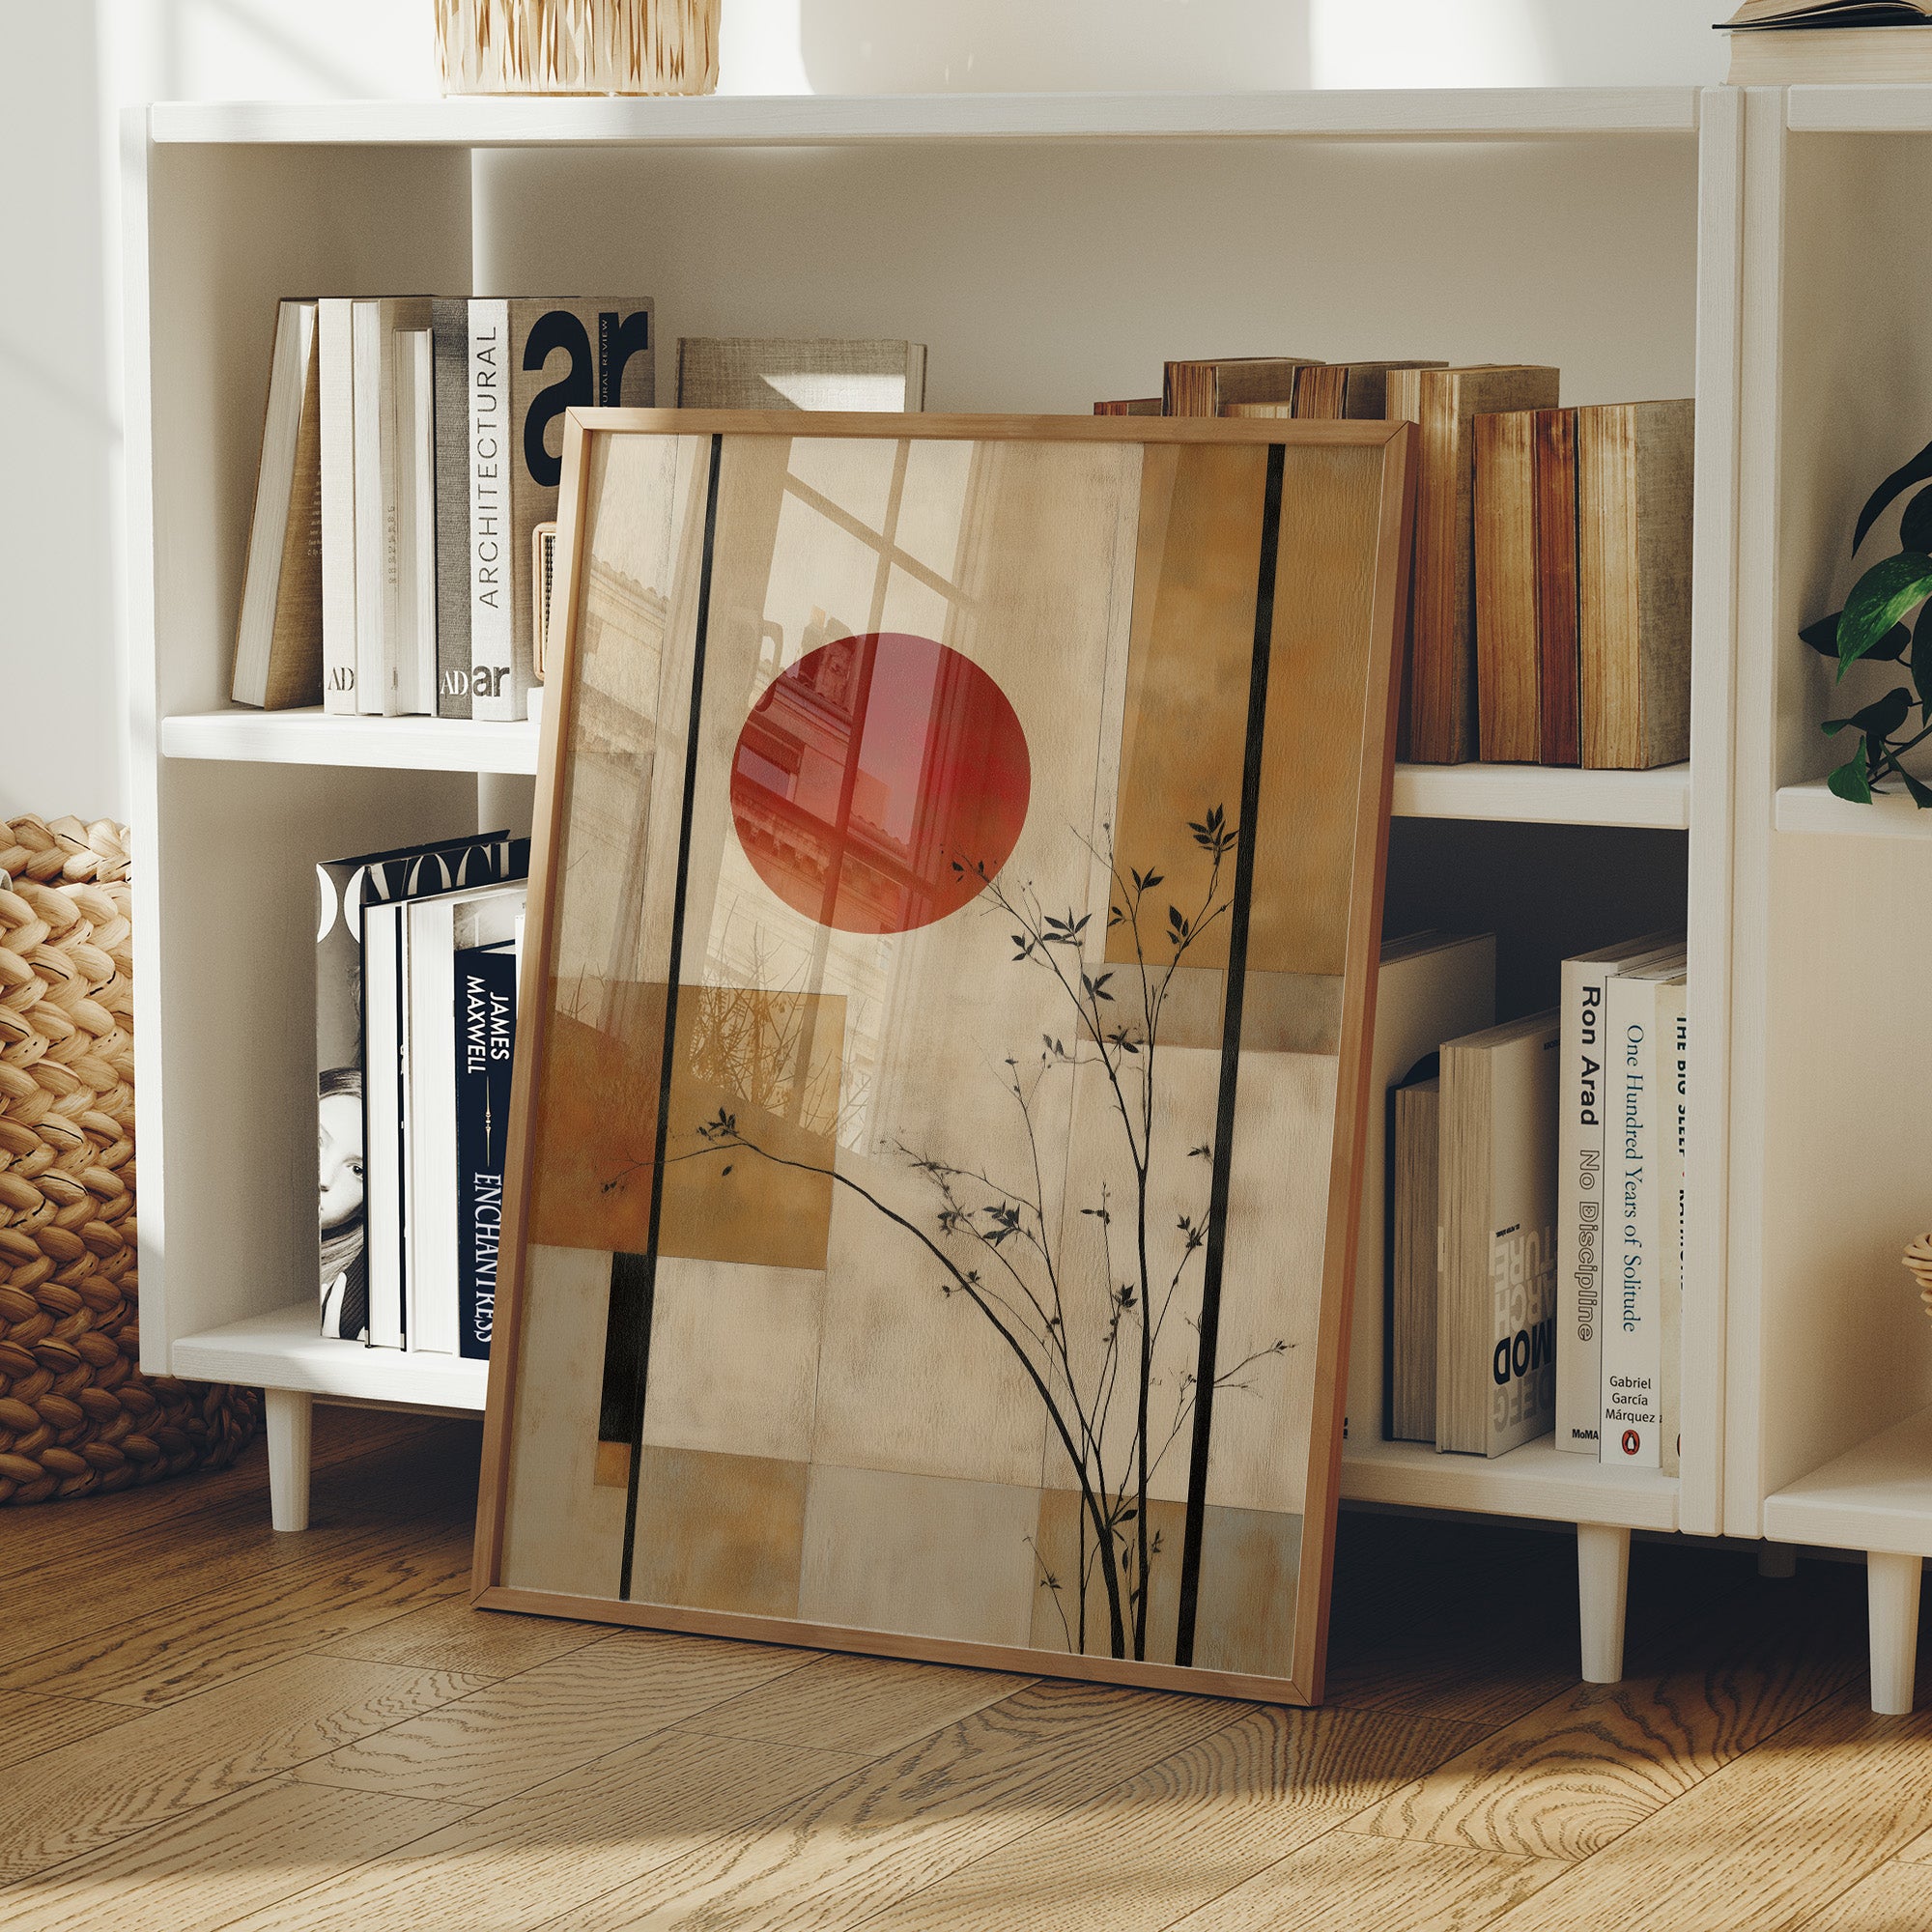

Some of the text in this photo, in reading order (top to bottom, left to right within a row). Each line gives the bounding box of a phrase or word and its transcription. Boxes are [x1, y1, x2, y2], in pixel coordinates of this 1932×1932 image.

[476, 327, 498, 609] ARCHITECTURAL
[327, 667, 355, 691] AD
[440, 669, 469, 696] AD
[472, 665, 510, 697] ar
[467, 975, 487, 1074] MAXWELL
[490, 991, 510, 1060] JAMES
[1574, 986, 1601, 1341] Ron Arad No Discipline
[1623, 1024, 1644, 1332] One Hundred Years of Solitude
[1609, 1376, 1651, 1389] Gabriel
[1611, 1392, 1648, 1406] García
[1605, 1408, 1655, 1424] Márquez
[1572, 1428, 1599, 1440] MoMA
